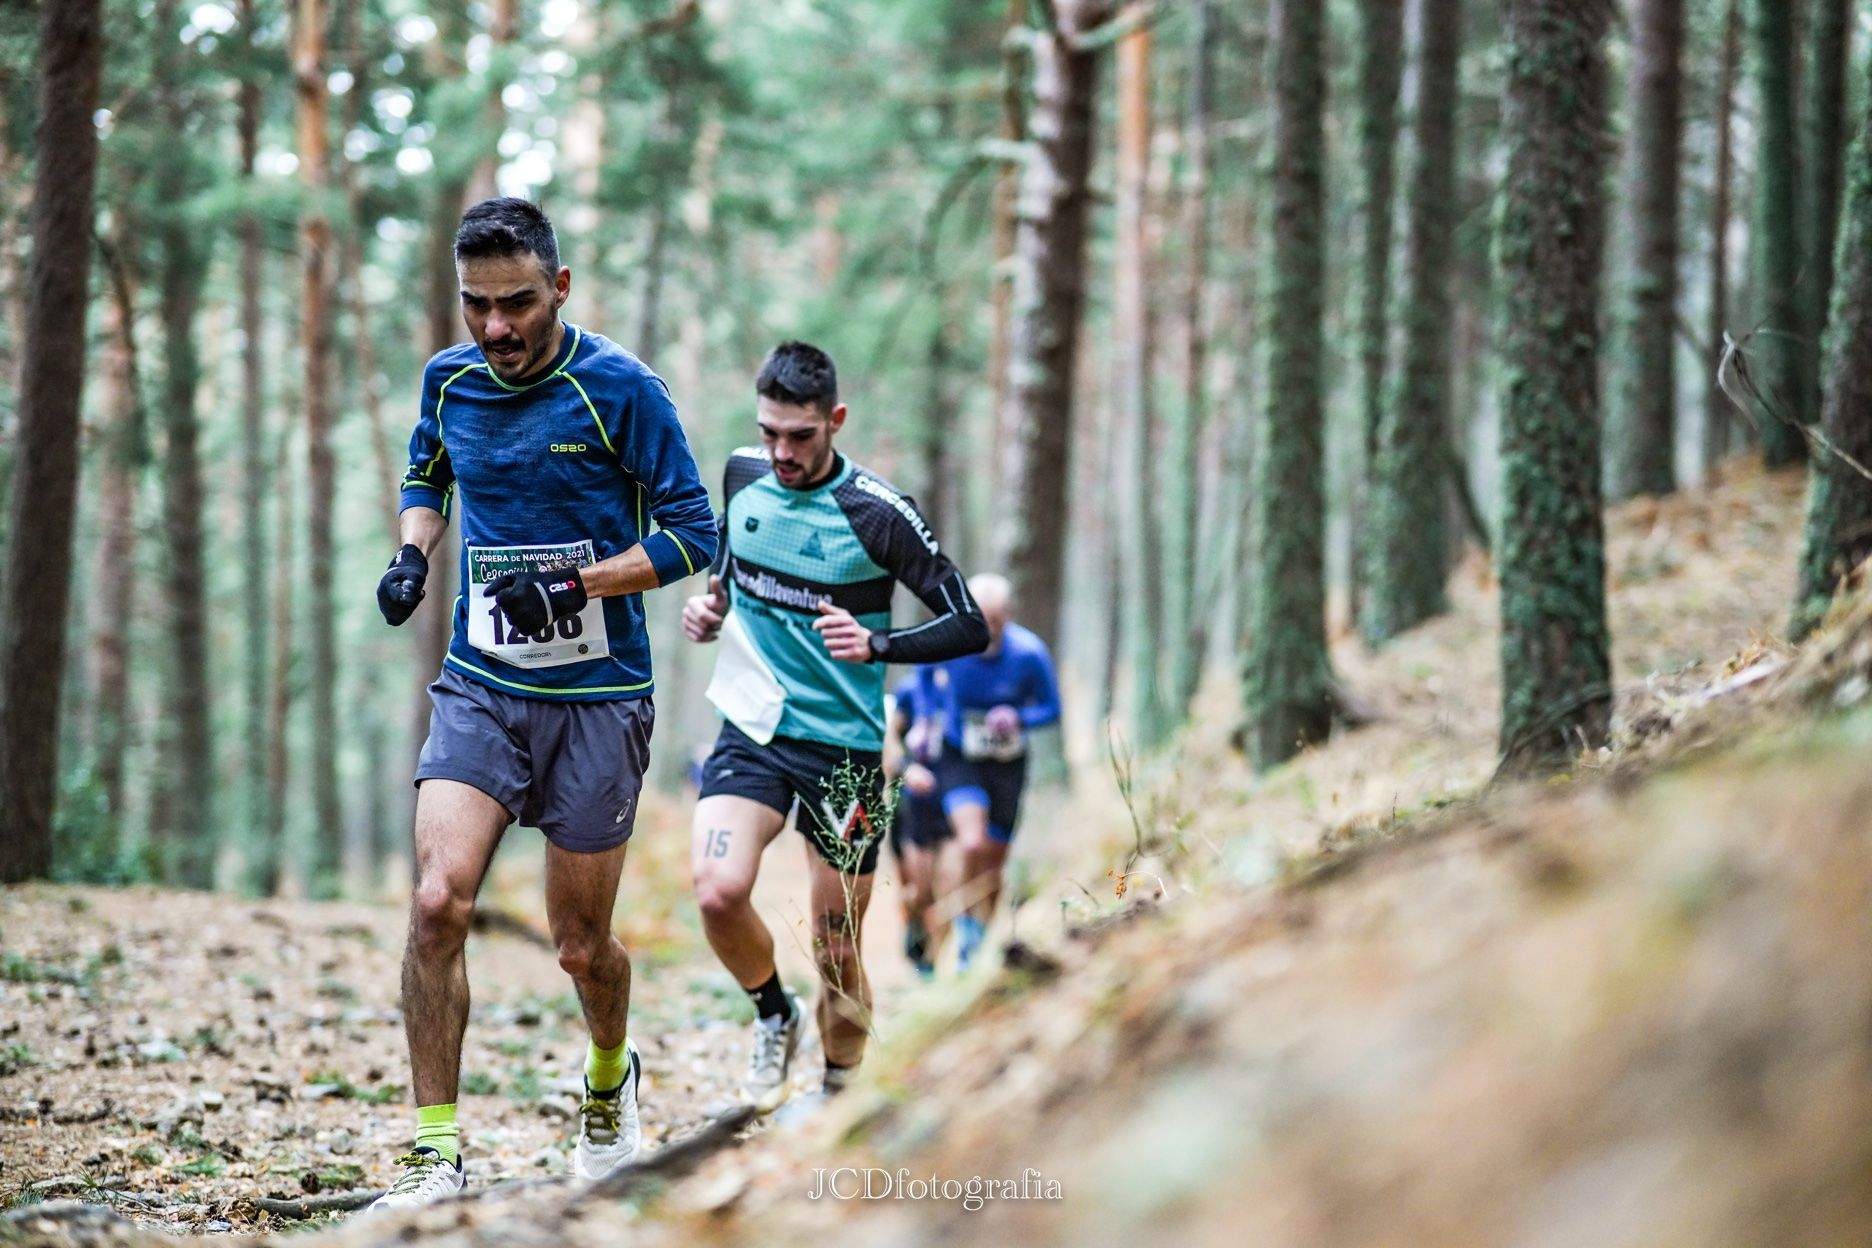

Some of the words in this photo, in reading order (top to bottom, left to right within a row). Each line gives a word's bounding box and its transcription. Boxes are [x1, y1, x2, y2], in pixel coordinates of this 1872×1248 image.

[474, 554, 509, 562] CARRERA
[523, 552, 562, 562] NAVIDAD
[566, 549, 585, 559] 2021
[705, 829, 732, 858] 15
